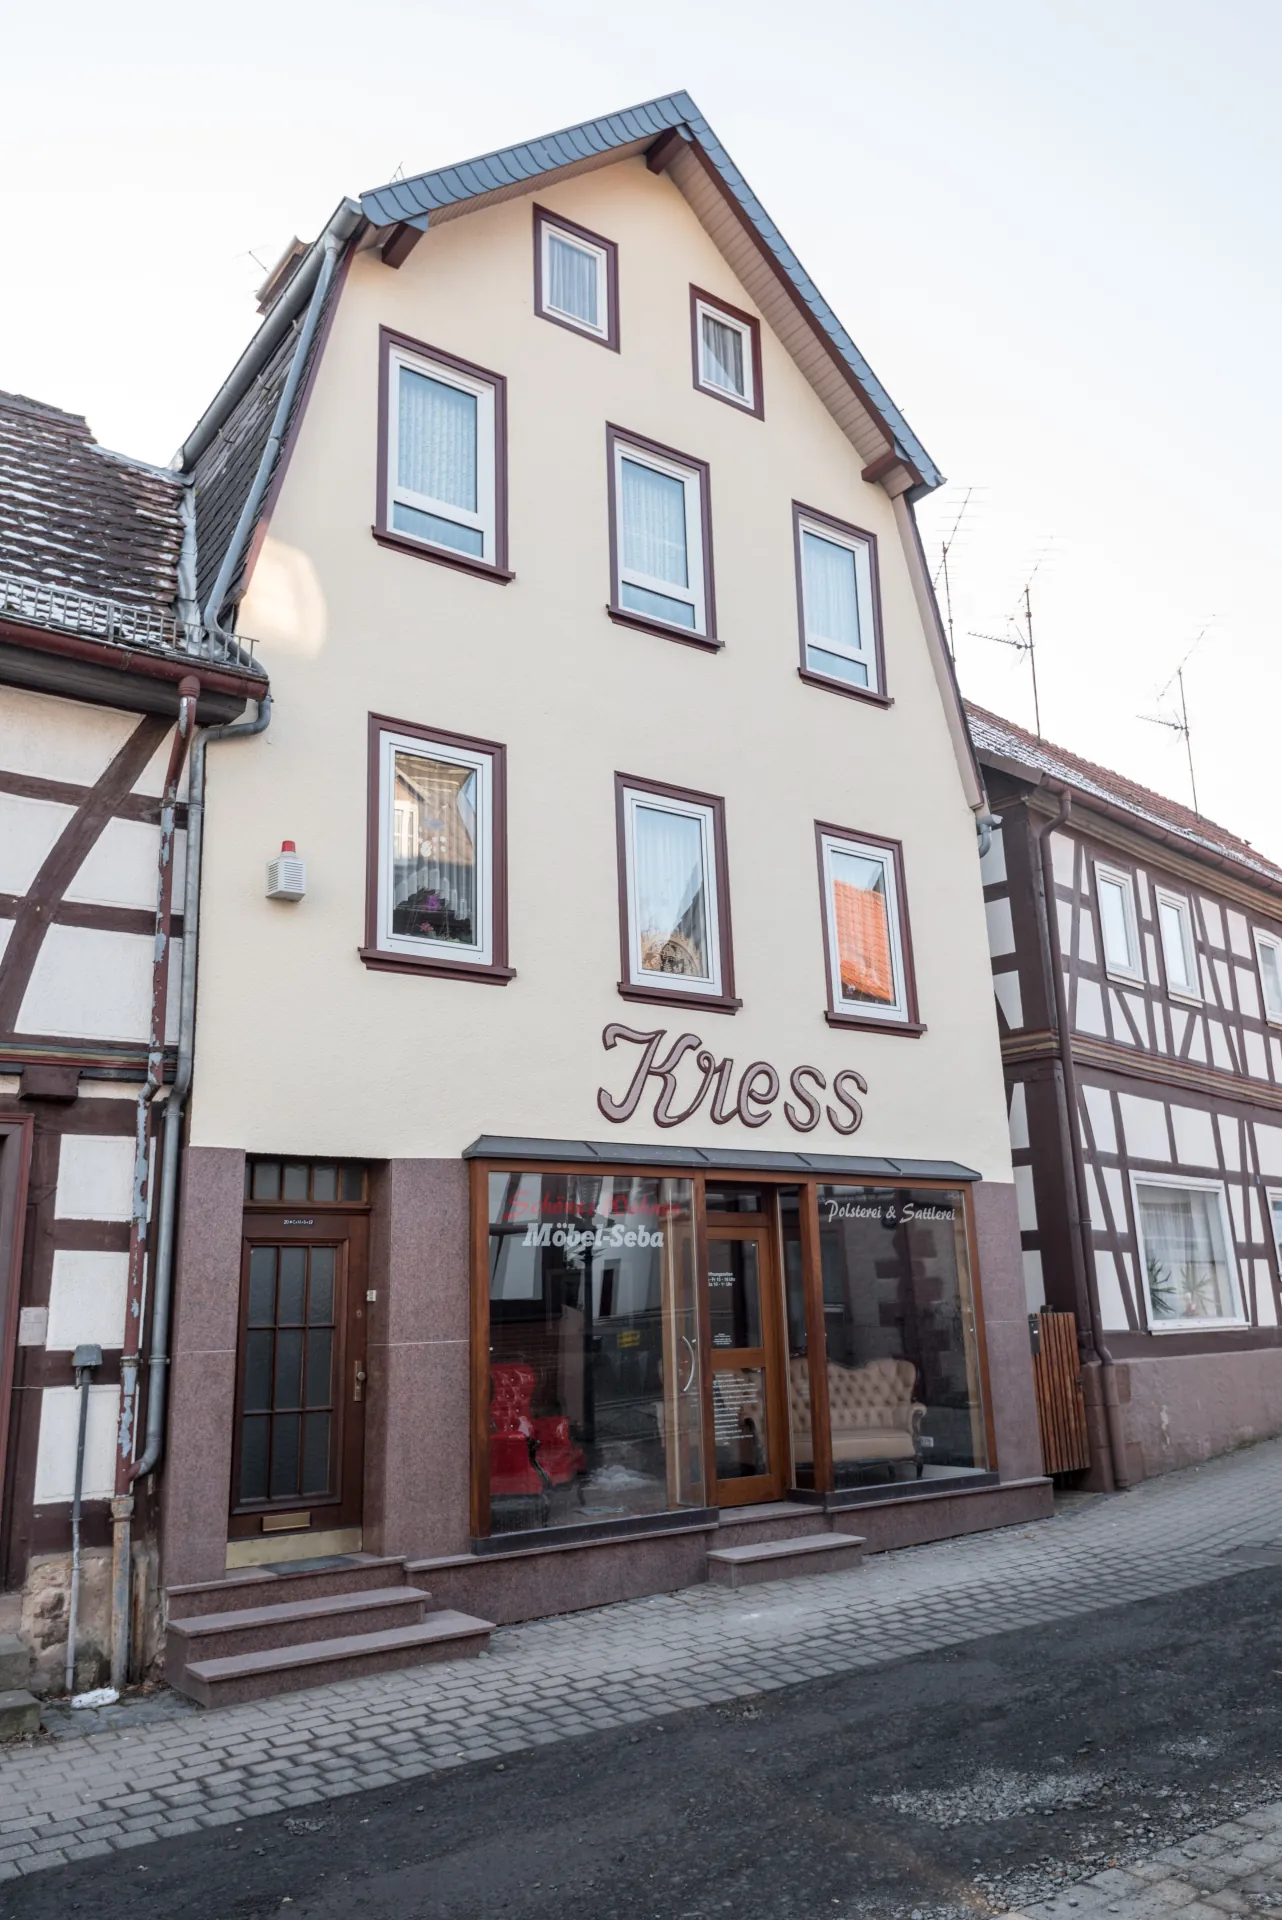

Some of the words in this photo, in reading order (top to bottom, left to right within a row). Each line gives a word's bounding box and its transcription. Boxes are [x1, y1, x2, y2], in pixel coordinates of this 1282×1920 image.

[597, 1023, 868, 1135] Kress
[825, 1200, 882, 1223] Polsterei
[886, 1205, 897, 1219] &
[900, 1203, 956, 1223] Sattlerei
[522, 1222, 664, 1248] Möbel-Seba
